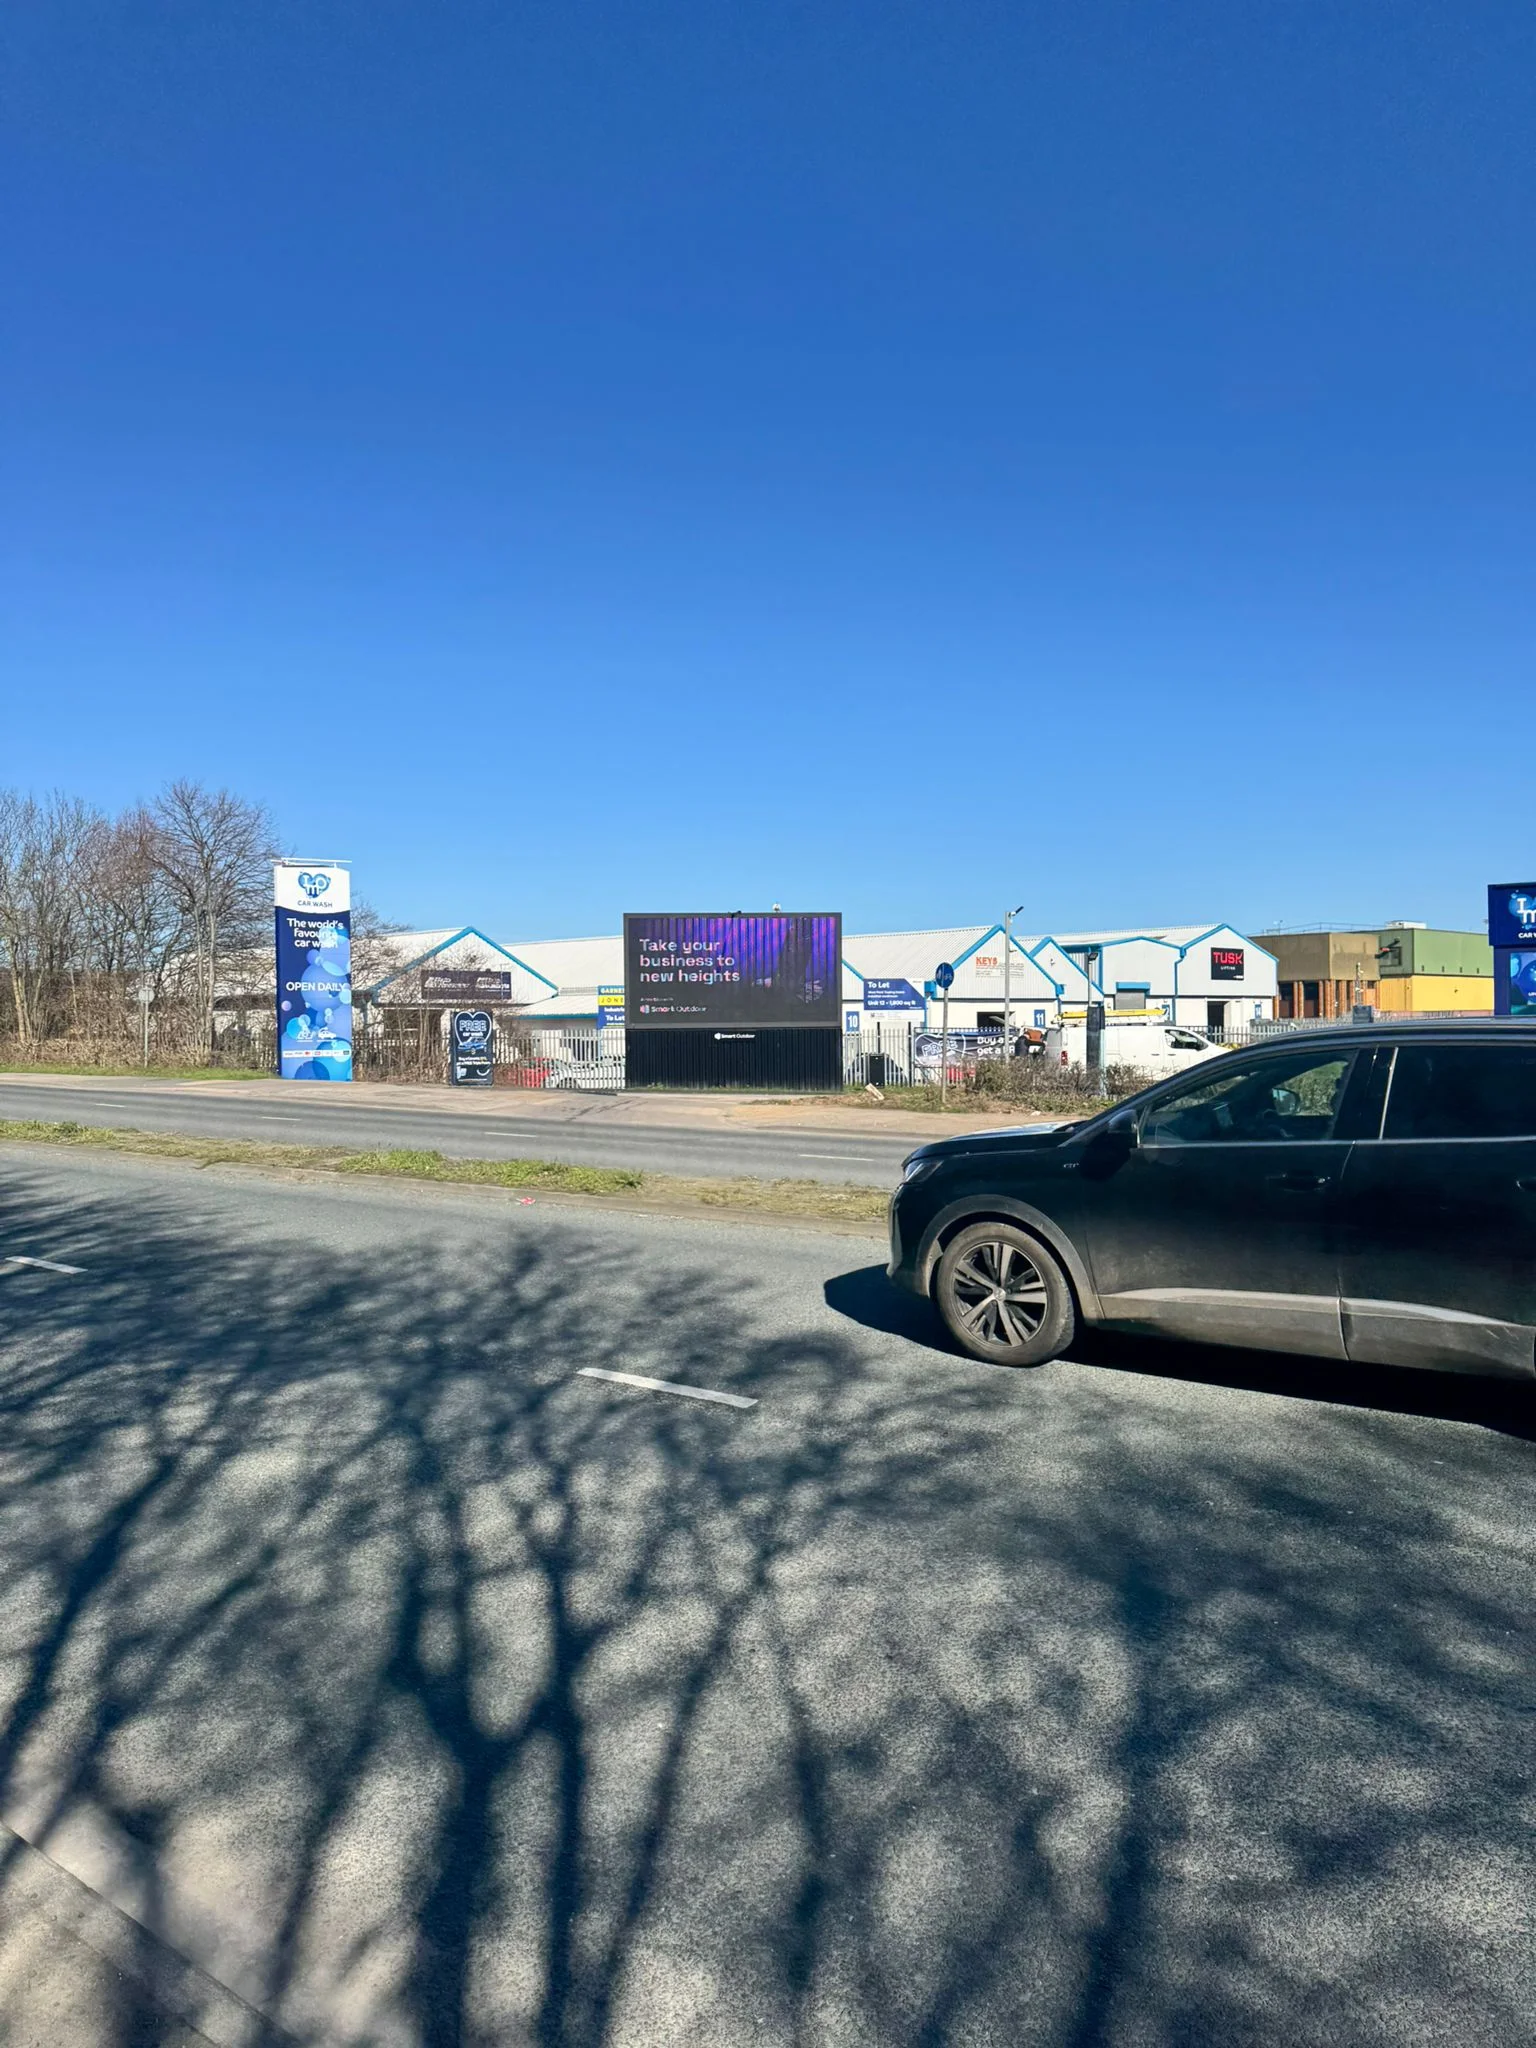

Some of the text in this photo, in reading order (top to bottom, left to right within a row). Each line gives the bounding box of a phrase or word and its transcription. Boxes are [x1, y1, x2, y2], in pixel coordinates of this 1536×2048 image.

[286, 917, 345, 930] The world's
[312, 940, 338, 949] wash
[639, 939, 720, 954] Take your
[640, 954, 735, 967] business to
[1213, 951, 1243, 964] TUSK
[640, 969, 740, 985] new heights
[286, 981, 345, 992] OPEN DAILY
[459, 1020, 487, 1031] FREE
[848, 1015, 858, 1027] 10
[1036, 1013, 1044, 1026] 11
[977, 1046, 993, 1057] get
